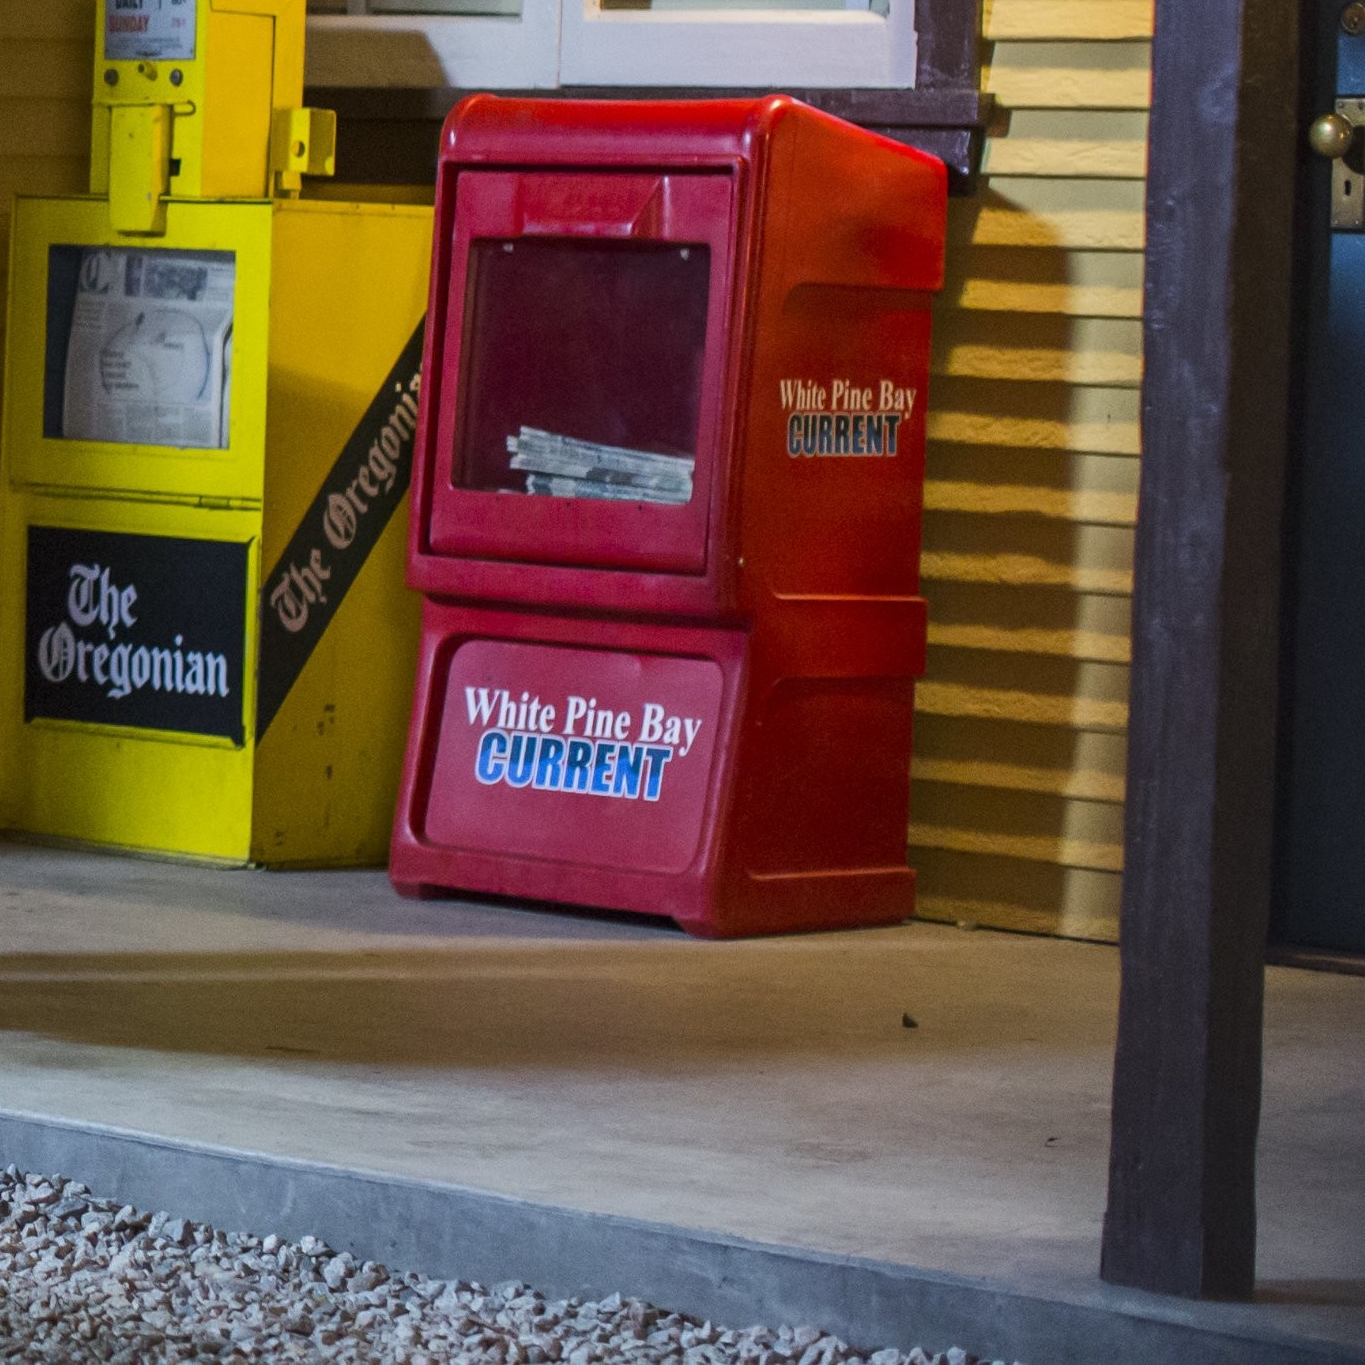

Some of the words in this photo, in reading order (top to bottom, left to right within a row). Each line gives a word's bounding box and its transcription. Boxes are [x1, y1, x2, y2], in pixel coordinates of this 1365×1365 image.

[780, 376, 827, 411] White
[830, 377, 874, 412] Pine
[878, 378, 917, 421] Bay
[787, 411, 903, 458] CURRENT
[68, 562, 139, 641] The
[270, 548, 332, 633] The
[37, 620, 231, 700] Oregonian
[464, 685, 557, 734] White
[562, 694, 632, 741] Pine
[639, 702, 703, 758] Bay
[474, 727, 674, 803] CURRENT
